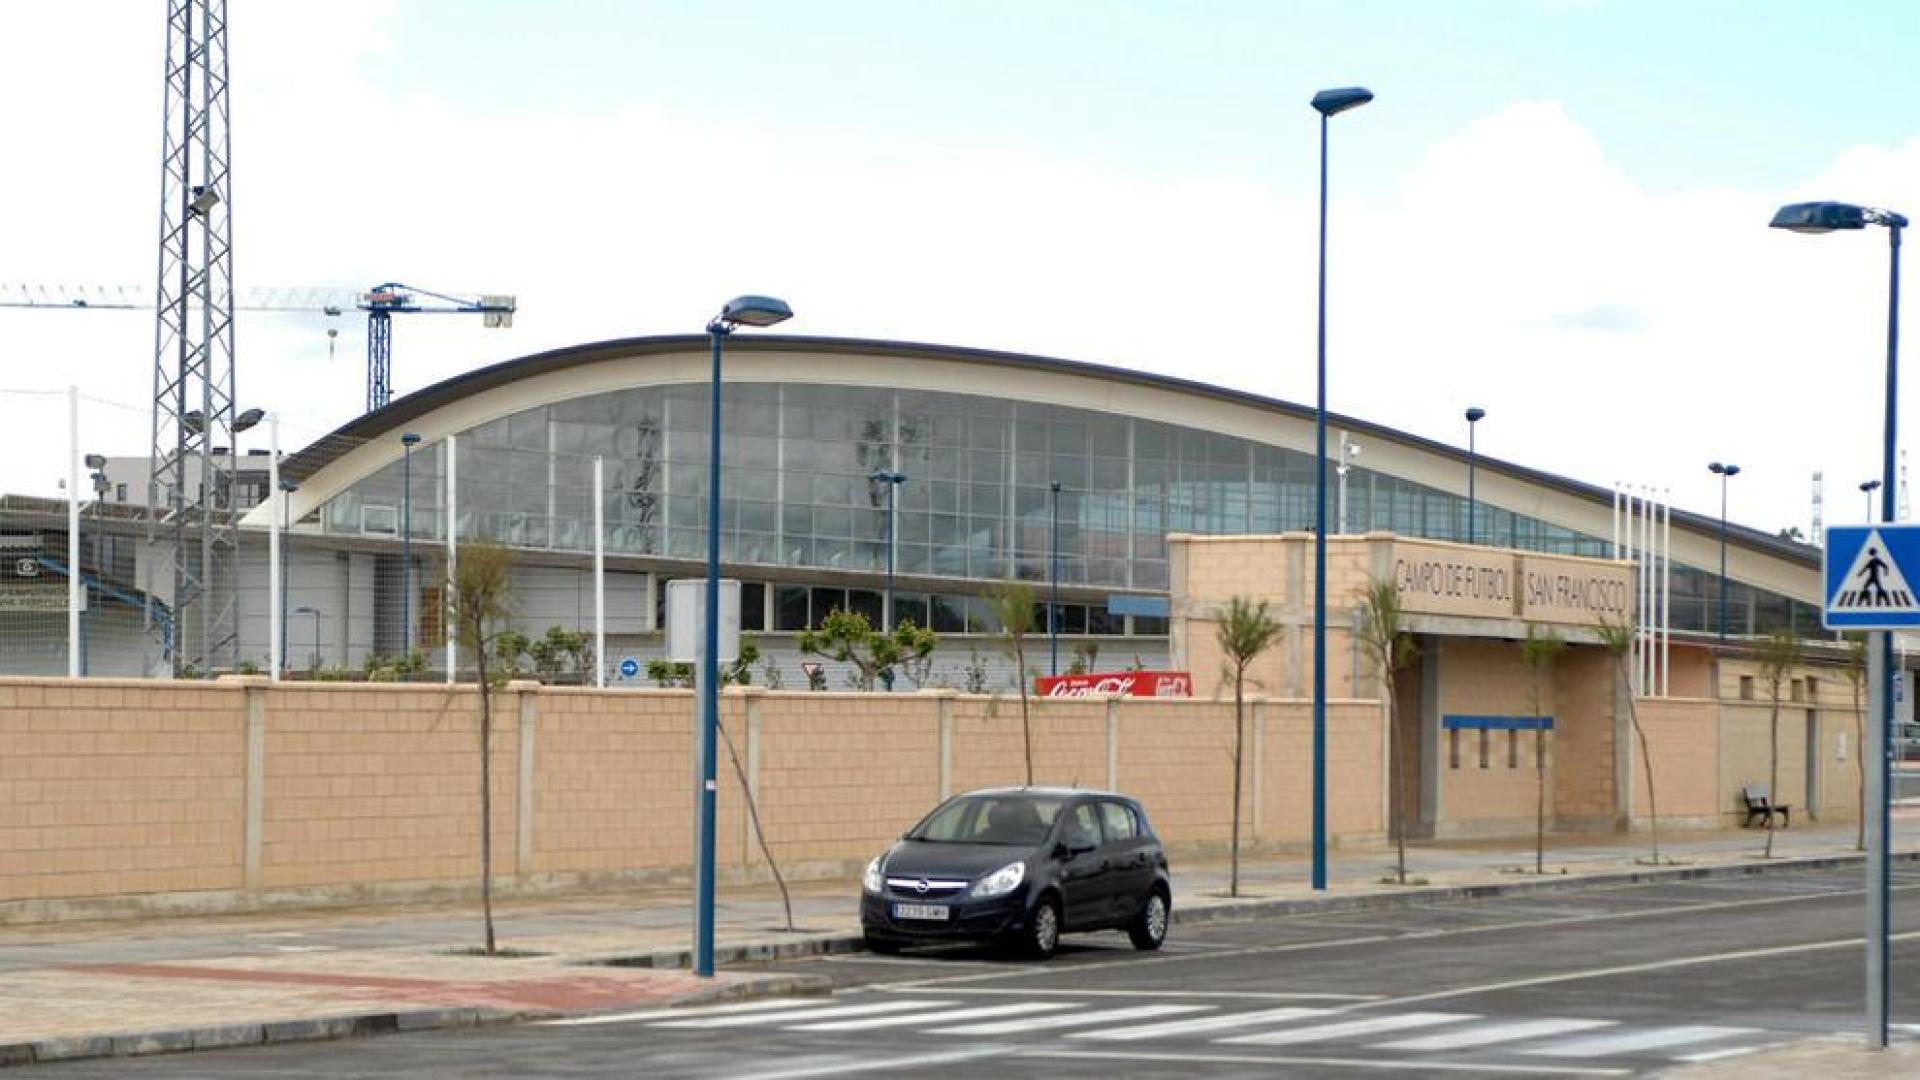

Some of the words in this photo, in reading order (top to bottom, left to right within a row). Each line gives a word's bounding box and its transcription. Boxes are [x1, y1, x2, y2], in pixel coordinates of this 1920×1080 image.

[1397, 559, 1441, 595] CAMPO
[1446, 563, 1463, 598] DE
[1527, 571, 1553, 606] SAN
[1557, 575, 1626, 614] FRANCISCO
